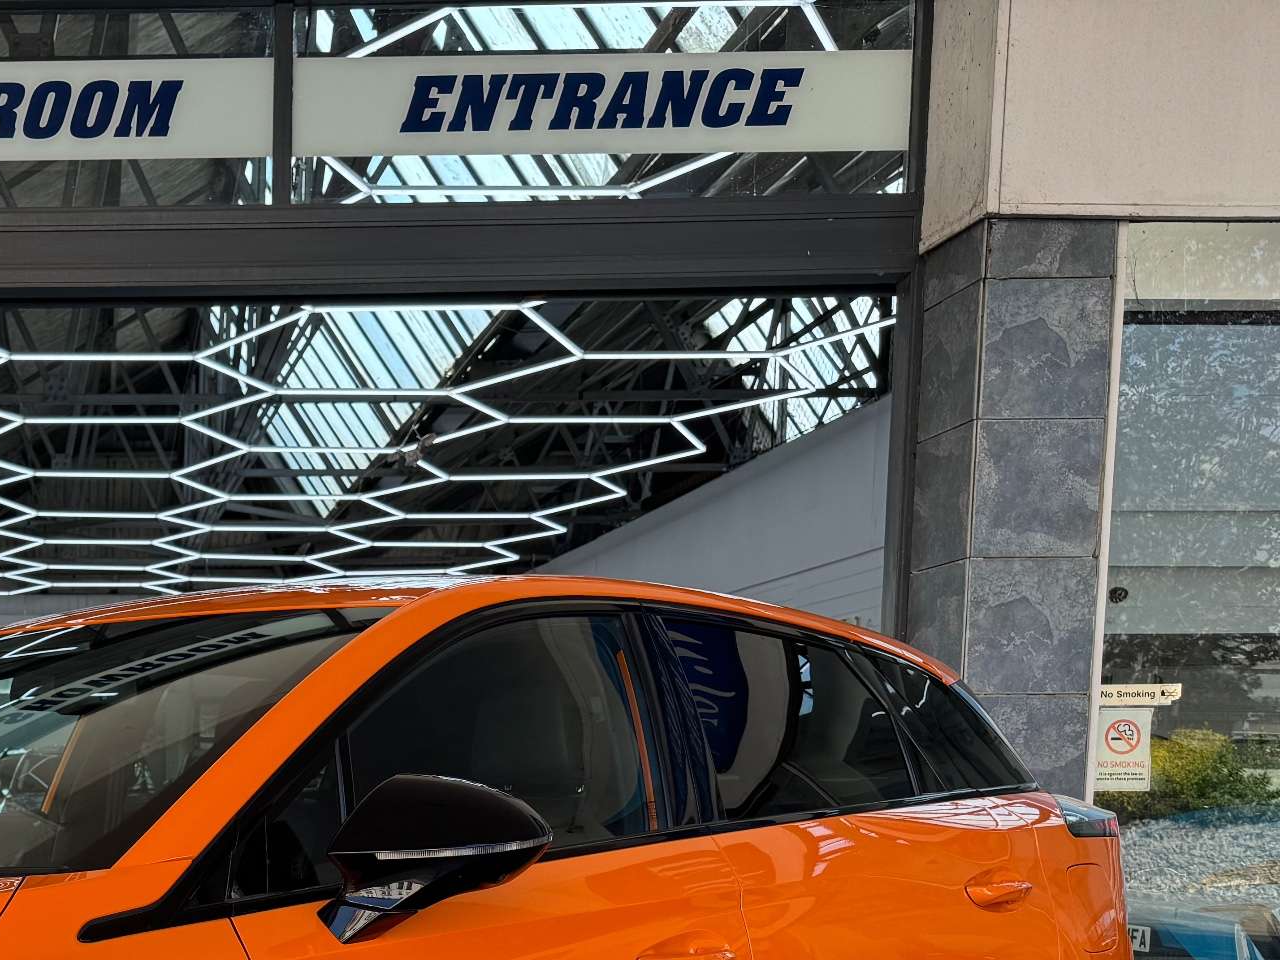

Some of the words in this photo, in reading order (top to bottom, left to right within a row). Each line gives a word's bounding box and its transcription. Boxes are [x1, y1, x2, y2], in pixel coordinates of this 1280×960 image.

[399, 67, 805, 133] ENTRANCE
[1100, 690, 1114, 699] No
[1116, 690, 1156, 700] Smoking
[1097, 761, 1109, 769] NO
[1110, 761, 1145, 769] SMOKING
